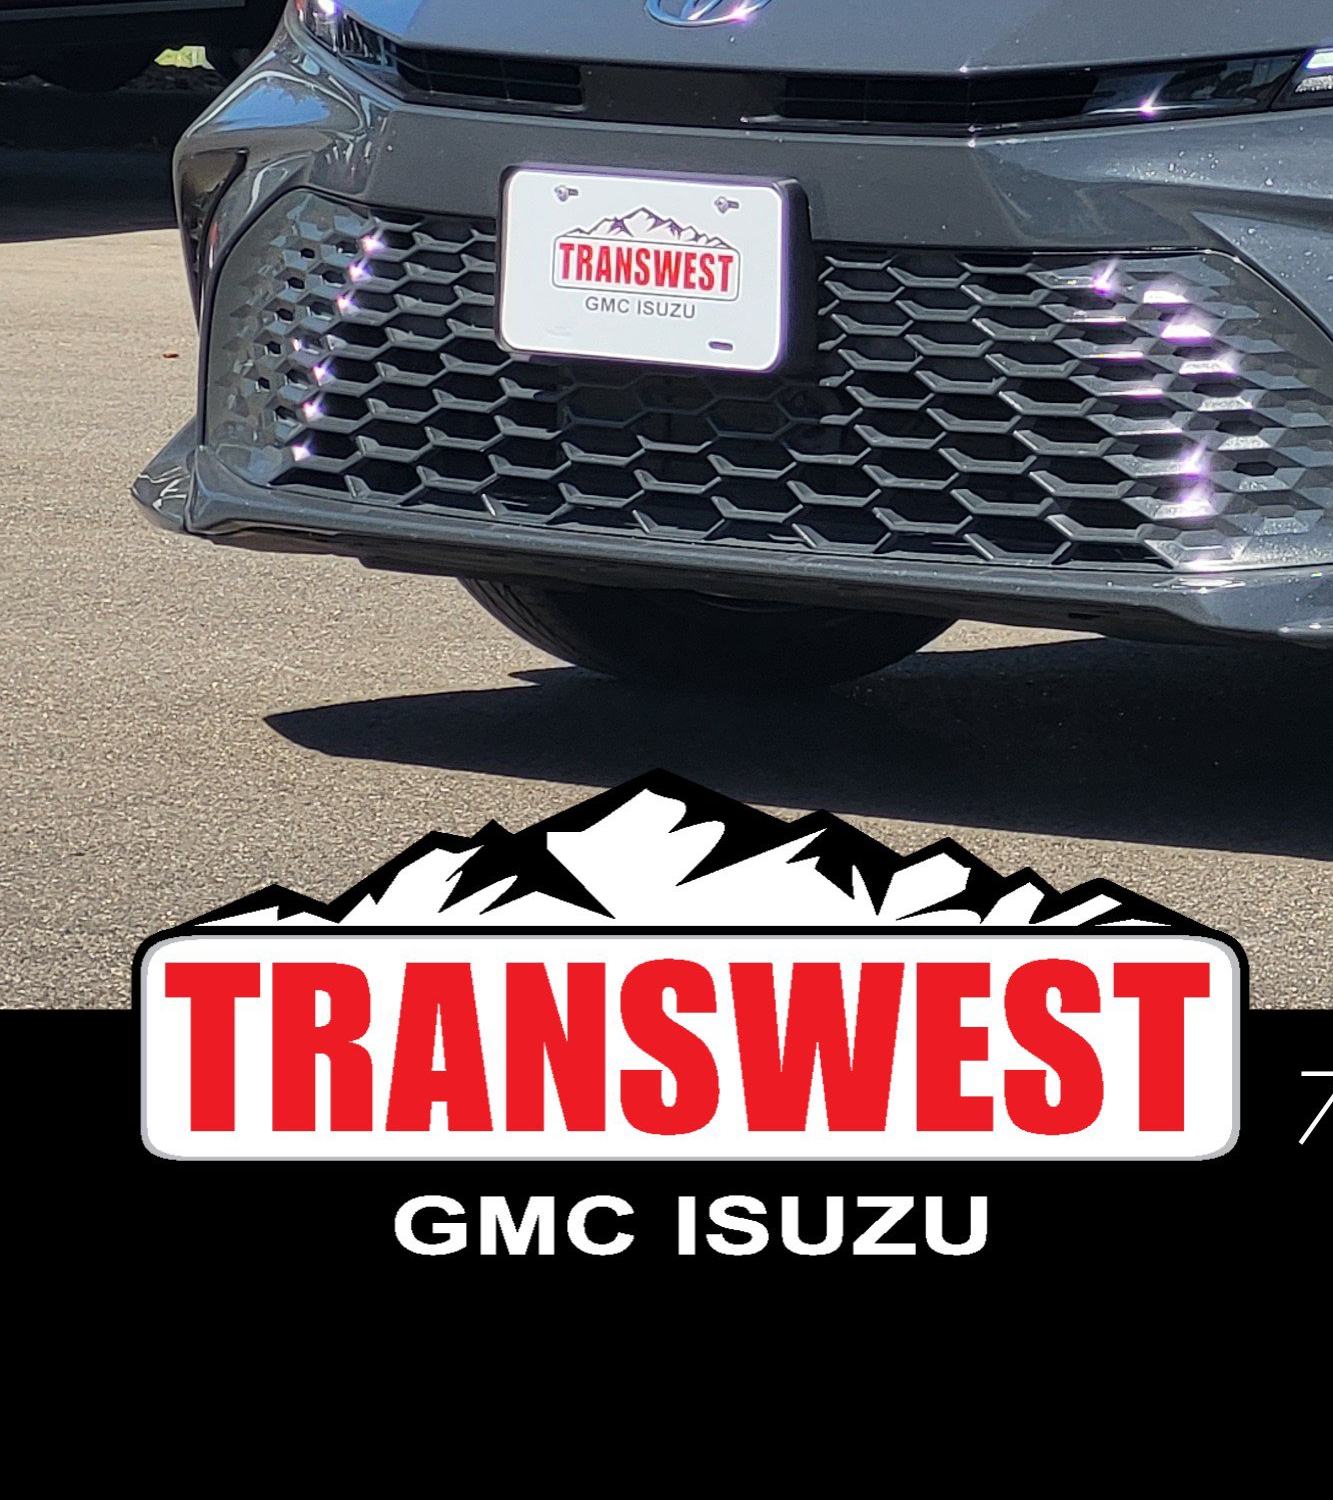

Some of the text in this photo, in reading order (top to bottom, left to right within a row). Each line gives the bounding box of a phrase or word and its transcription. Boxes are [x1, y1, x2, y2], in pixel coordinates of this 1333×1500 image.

[559, 242, 734, 293] TRANSWEST
[585, 295, 696, 319] GMC ISUZU
